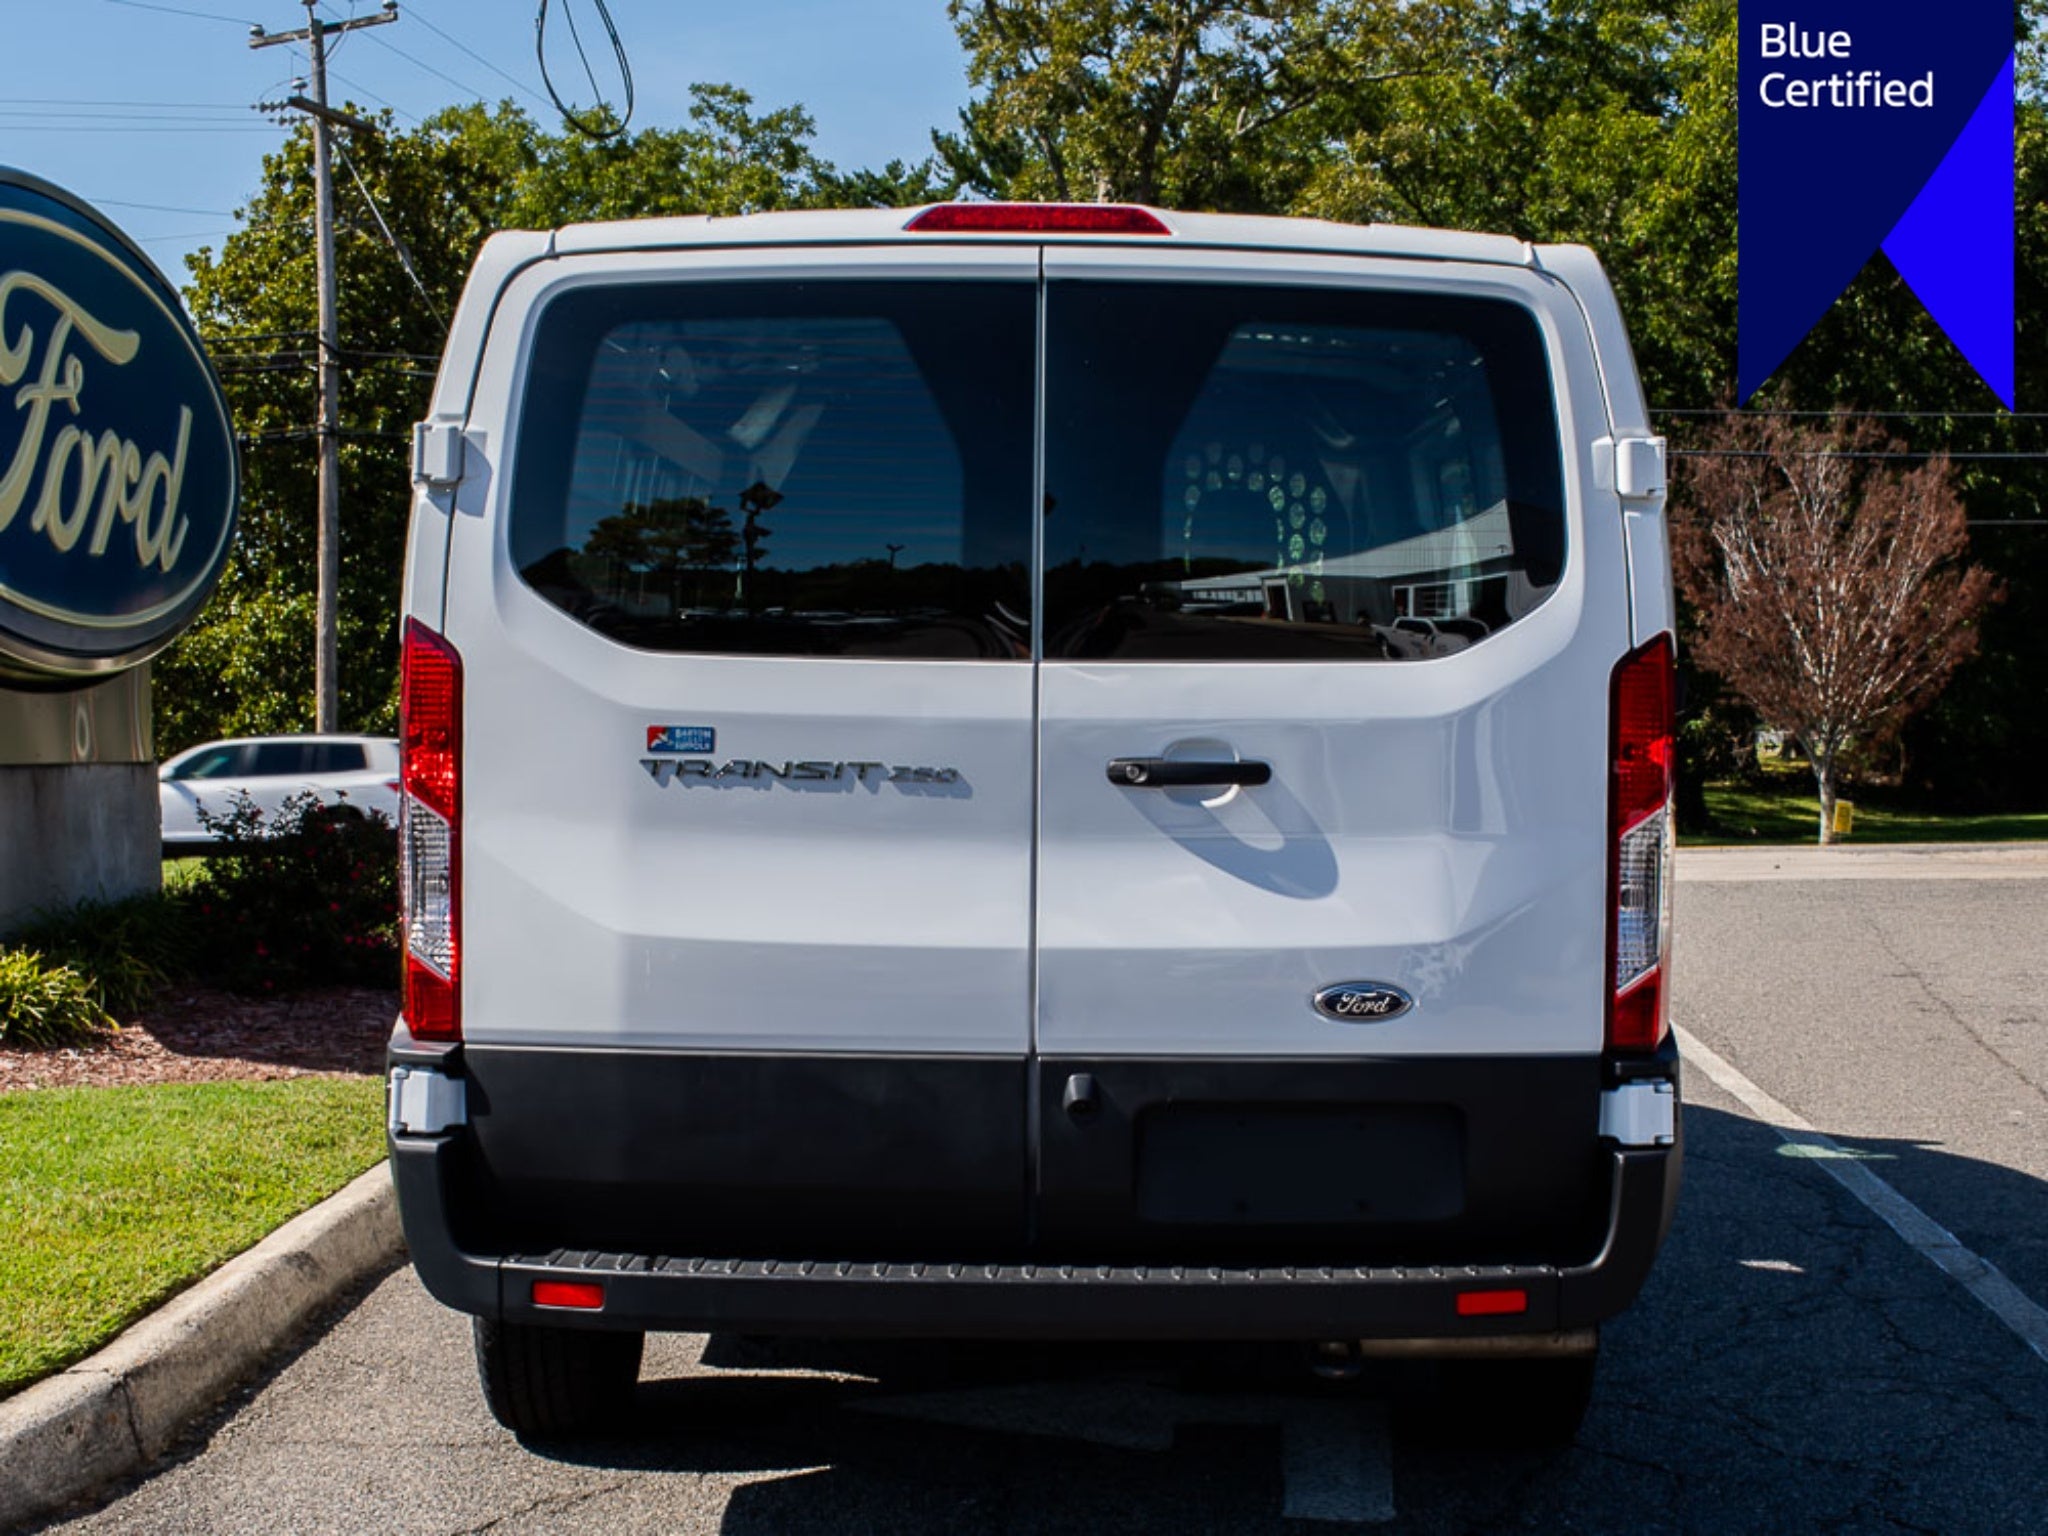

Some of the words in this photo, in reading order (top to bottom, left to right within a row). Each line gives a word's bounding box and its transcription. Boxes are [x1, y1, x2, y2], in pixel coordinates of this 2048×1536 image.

[0, 270, 193, 573] Ford
[639, 759, 884, 780] TRANSIT
[1336, 990, 1391, 1013] Ford
